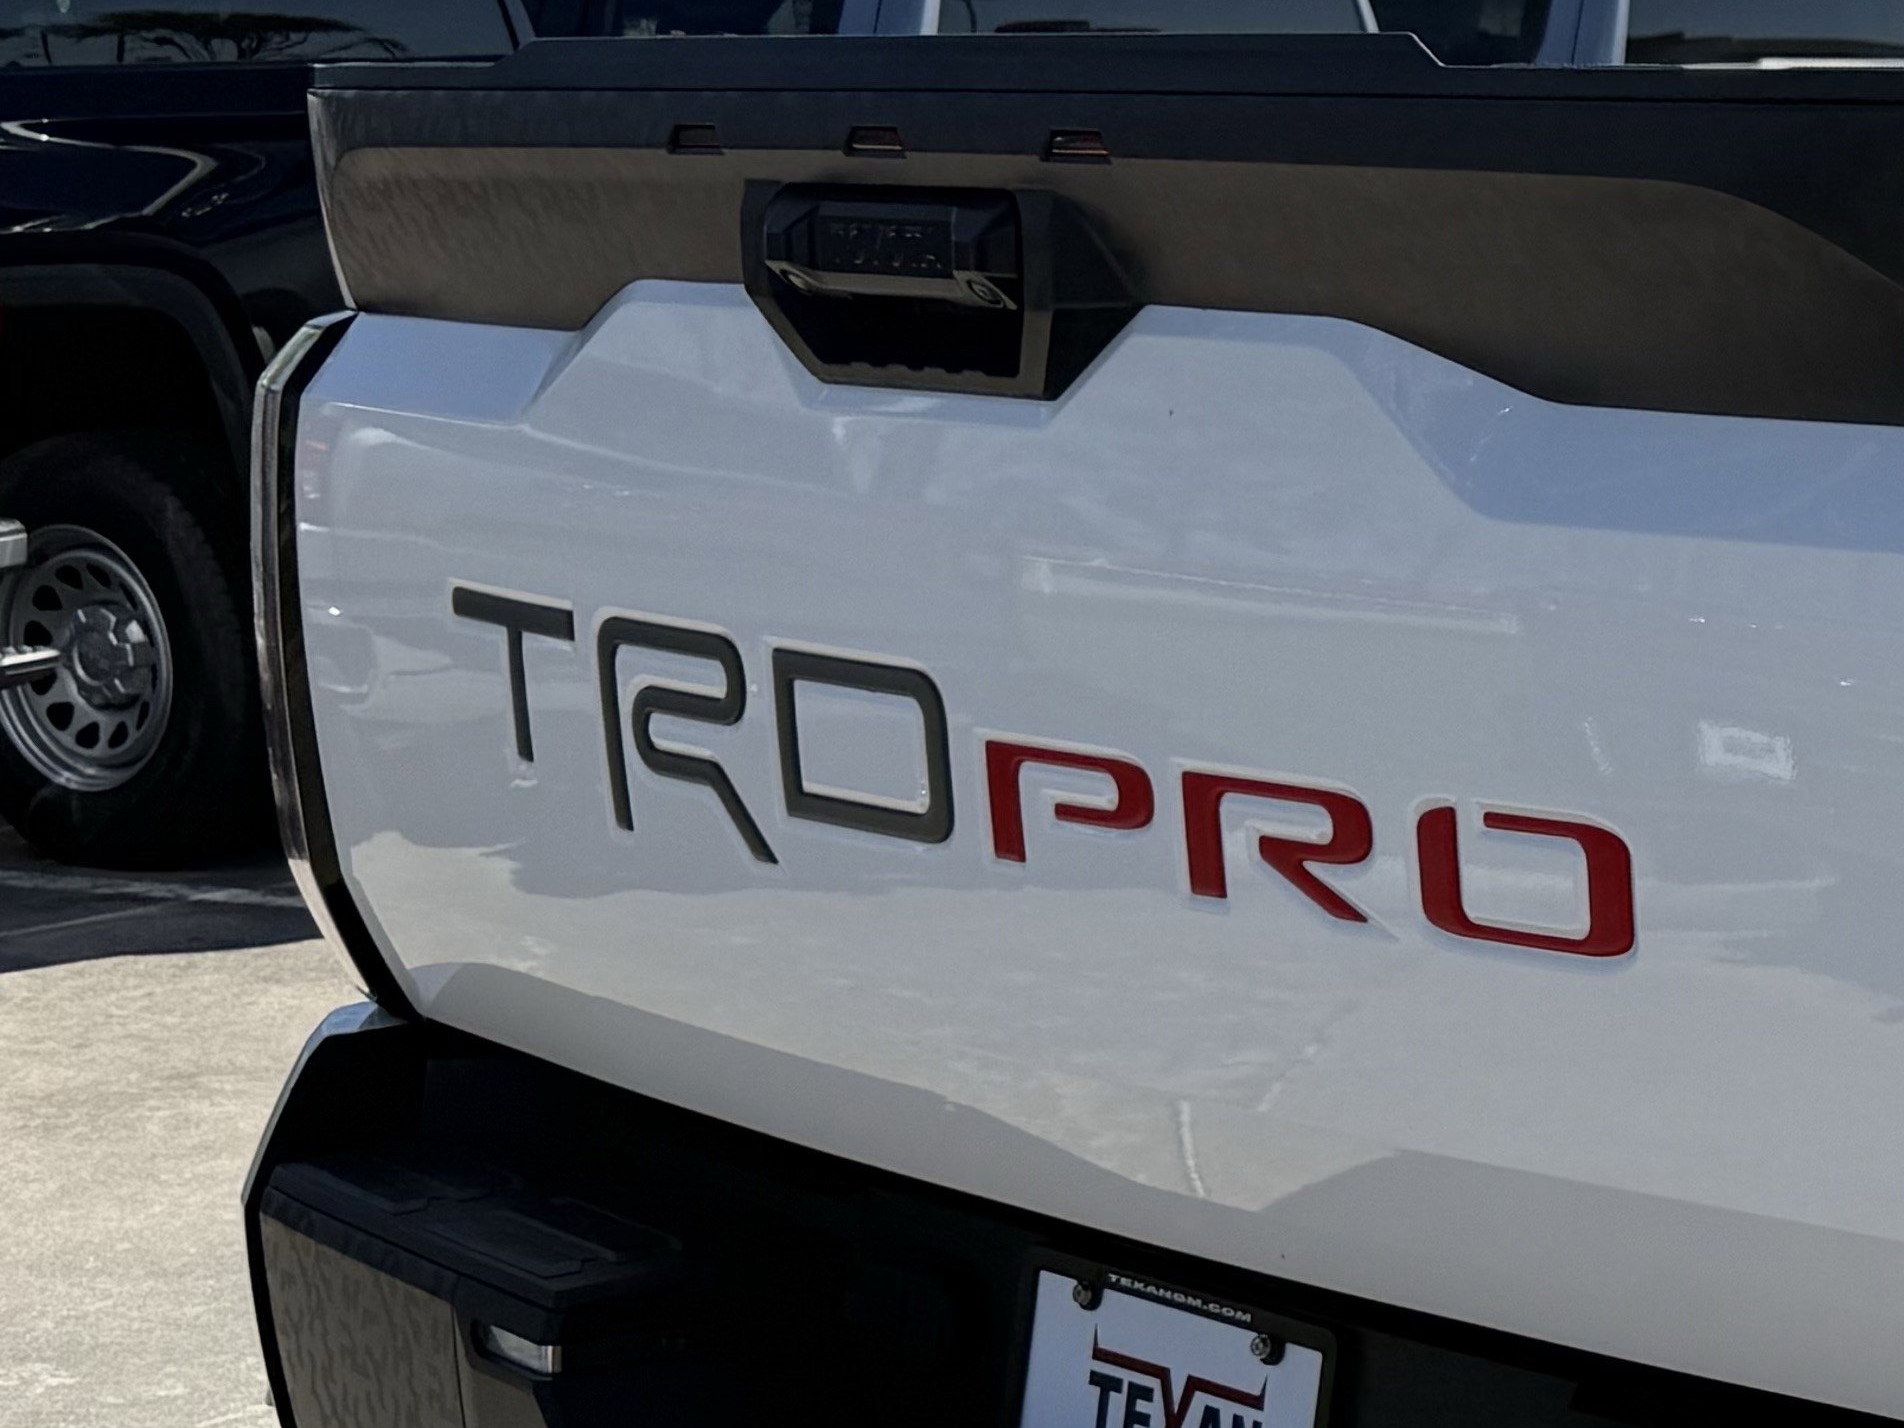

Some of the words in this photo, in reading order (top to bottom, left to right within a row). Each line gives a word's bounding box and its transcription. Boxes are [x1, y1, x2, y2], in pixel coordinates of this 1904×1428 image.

[450, 584, 955, 866] TRD
[984, 738, 1634, 959] PRO
[1107, 1272, 1252, 1323] TEXANGM.COM
